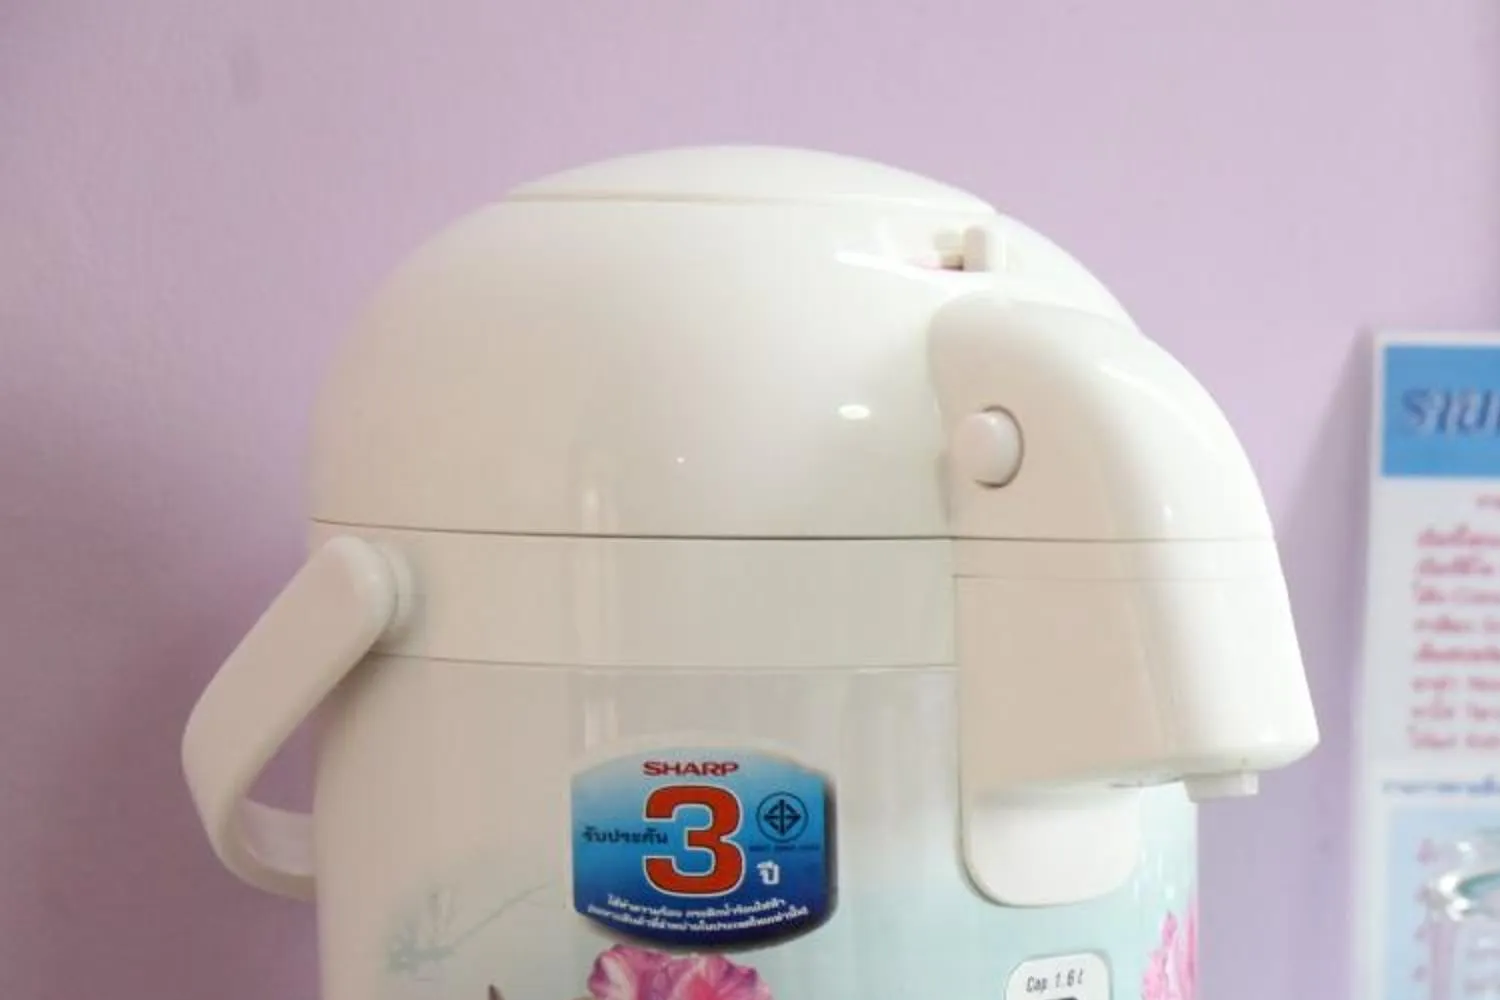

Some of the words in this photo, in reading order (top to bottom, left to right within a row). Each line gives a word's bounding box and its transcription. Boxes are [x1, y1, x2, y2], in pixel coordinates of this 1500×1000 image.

[643, 761, 739, 776] SHARP
[582, 826, 668, 845] รับประกัน
[644, 784, 746, 897] 3
[756, 859, 780, 885] ปี
